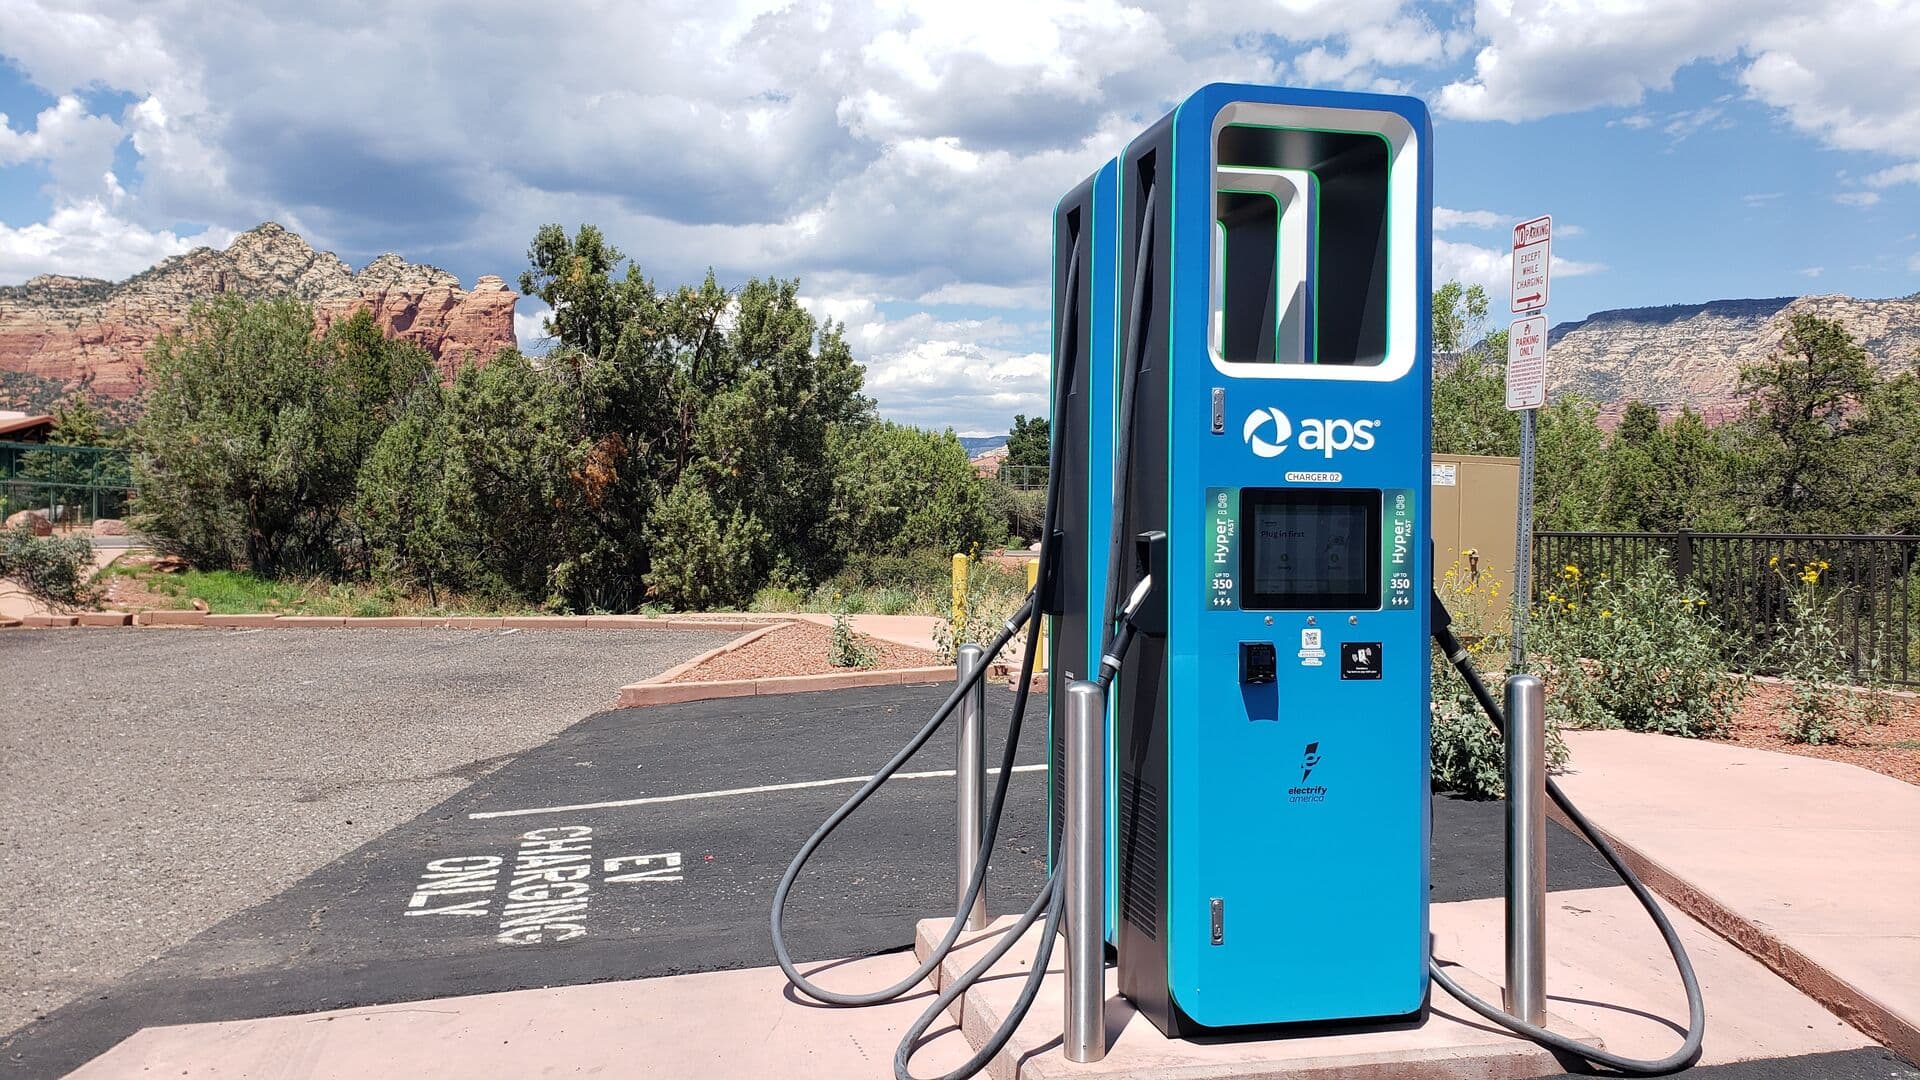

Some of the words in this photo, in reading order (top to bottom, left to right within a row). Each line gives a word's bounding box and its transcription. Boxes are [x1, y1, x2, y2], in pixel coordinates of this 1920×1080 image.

[1514, 228, 1525, 247] NO
[1525, 223, 1549, 241] PARKING
[1521, 251, 1541, 264] EXCEPT
[1522, 264, 1539, 275] WHILE
[1517, 276, 1543, 289] CHARGING
[1524, 325, 1531, 336] EV
[1516, 335, 1540, 347] PARKING
[1520, 345, 1534, 356] ONLY
[1287, 473, 1328, 481] CHARGER
[1329, 473, 1340, 481] 02
[1261, 530, 1279, 539] Plug
[1288, 530, 1305, 538] first
[1214, 518, 1229, 564] Hyper
[1392, 518, 1407, 564] Hyper
[1212, 579, 1233, 589] 350
[1390, 579, 1410, 589] 350
[1288, 786, 1328, 796] electrify
[604, 852, 684, 883] EV
[404, 855, 503, 917] ONLY
[496, 825, 593, 945] CHARGING
